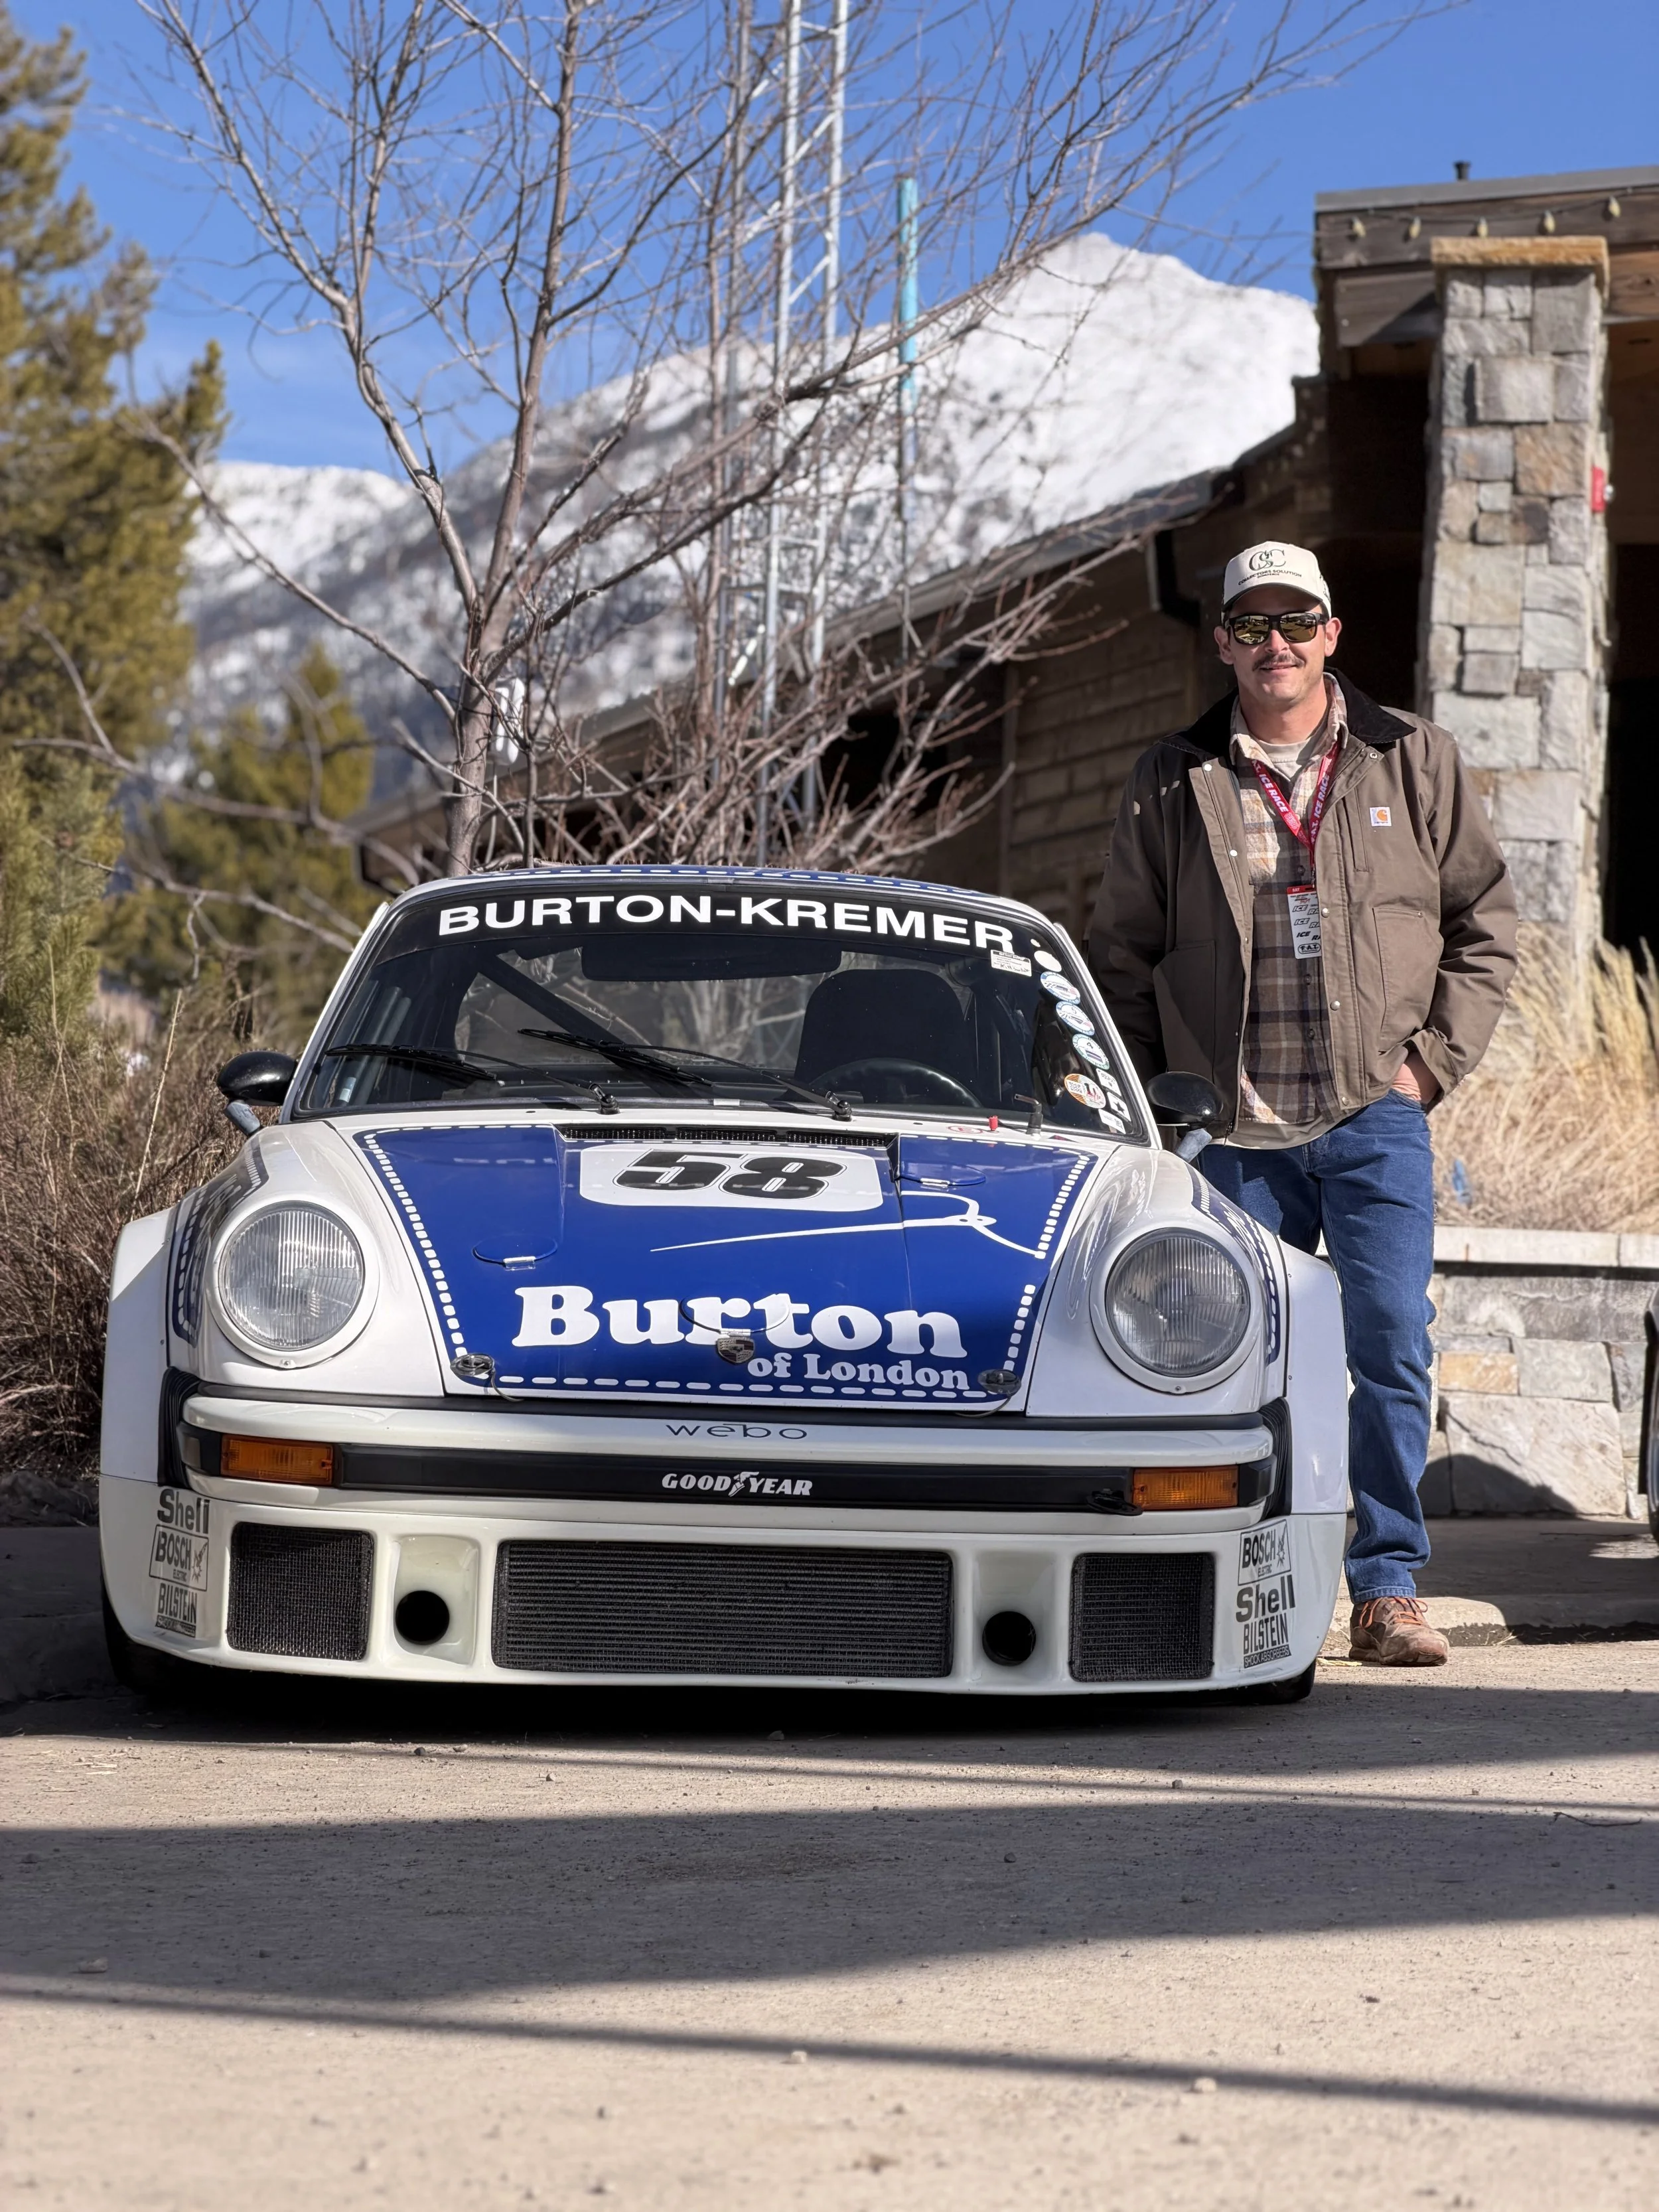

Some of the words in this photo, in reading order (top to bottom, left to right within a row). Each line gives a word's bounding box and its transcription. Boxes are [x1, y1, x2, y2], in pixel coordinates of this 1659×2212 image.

[1238, 570, 1271, 585] COLLECTORS
[1259, 774, 1273, 789] ICE
[1268, 789, 1289, 812] RACE
[1314, 801, 1323, 818] ICE
[1319, 774, 1330, 801] RACE
[439, 894, 1014, 954] BURTON-KREMER
[612, 1149, 846, 1200] 58
[512, 1285, 968, 1358] Burton
[747, 1353, 792, 1378] of
[804, 1353, 970, 1390] London
[157, 1488, 210, 1534] Shell
[155, 1530, 192, 1571] BOSCH
[1242, 1529, 1276, 1569] BOSCH
[157, 1583, 197, 1624] BILSTEIN
[1236, 1574, 1296, 1623] Shell
[1244, 1613, 1289, 1655] BILSTEIN
[1244, 1652, 1262, 1668] SHOCK
[1260, 1646, 1290, 1663] ABSORBERS
